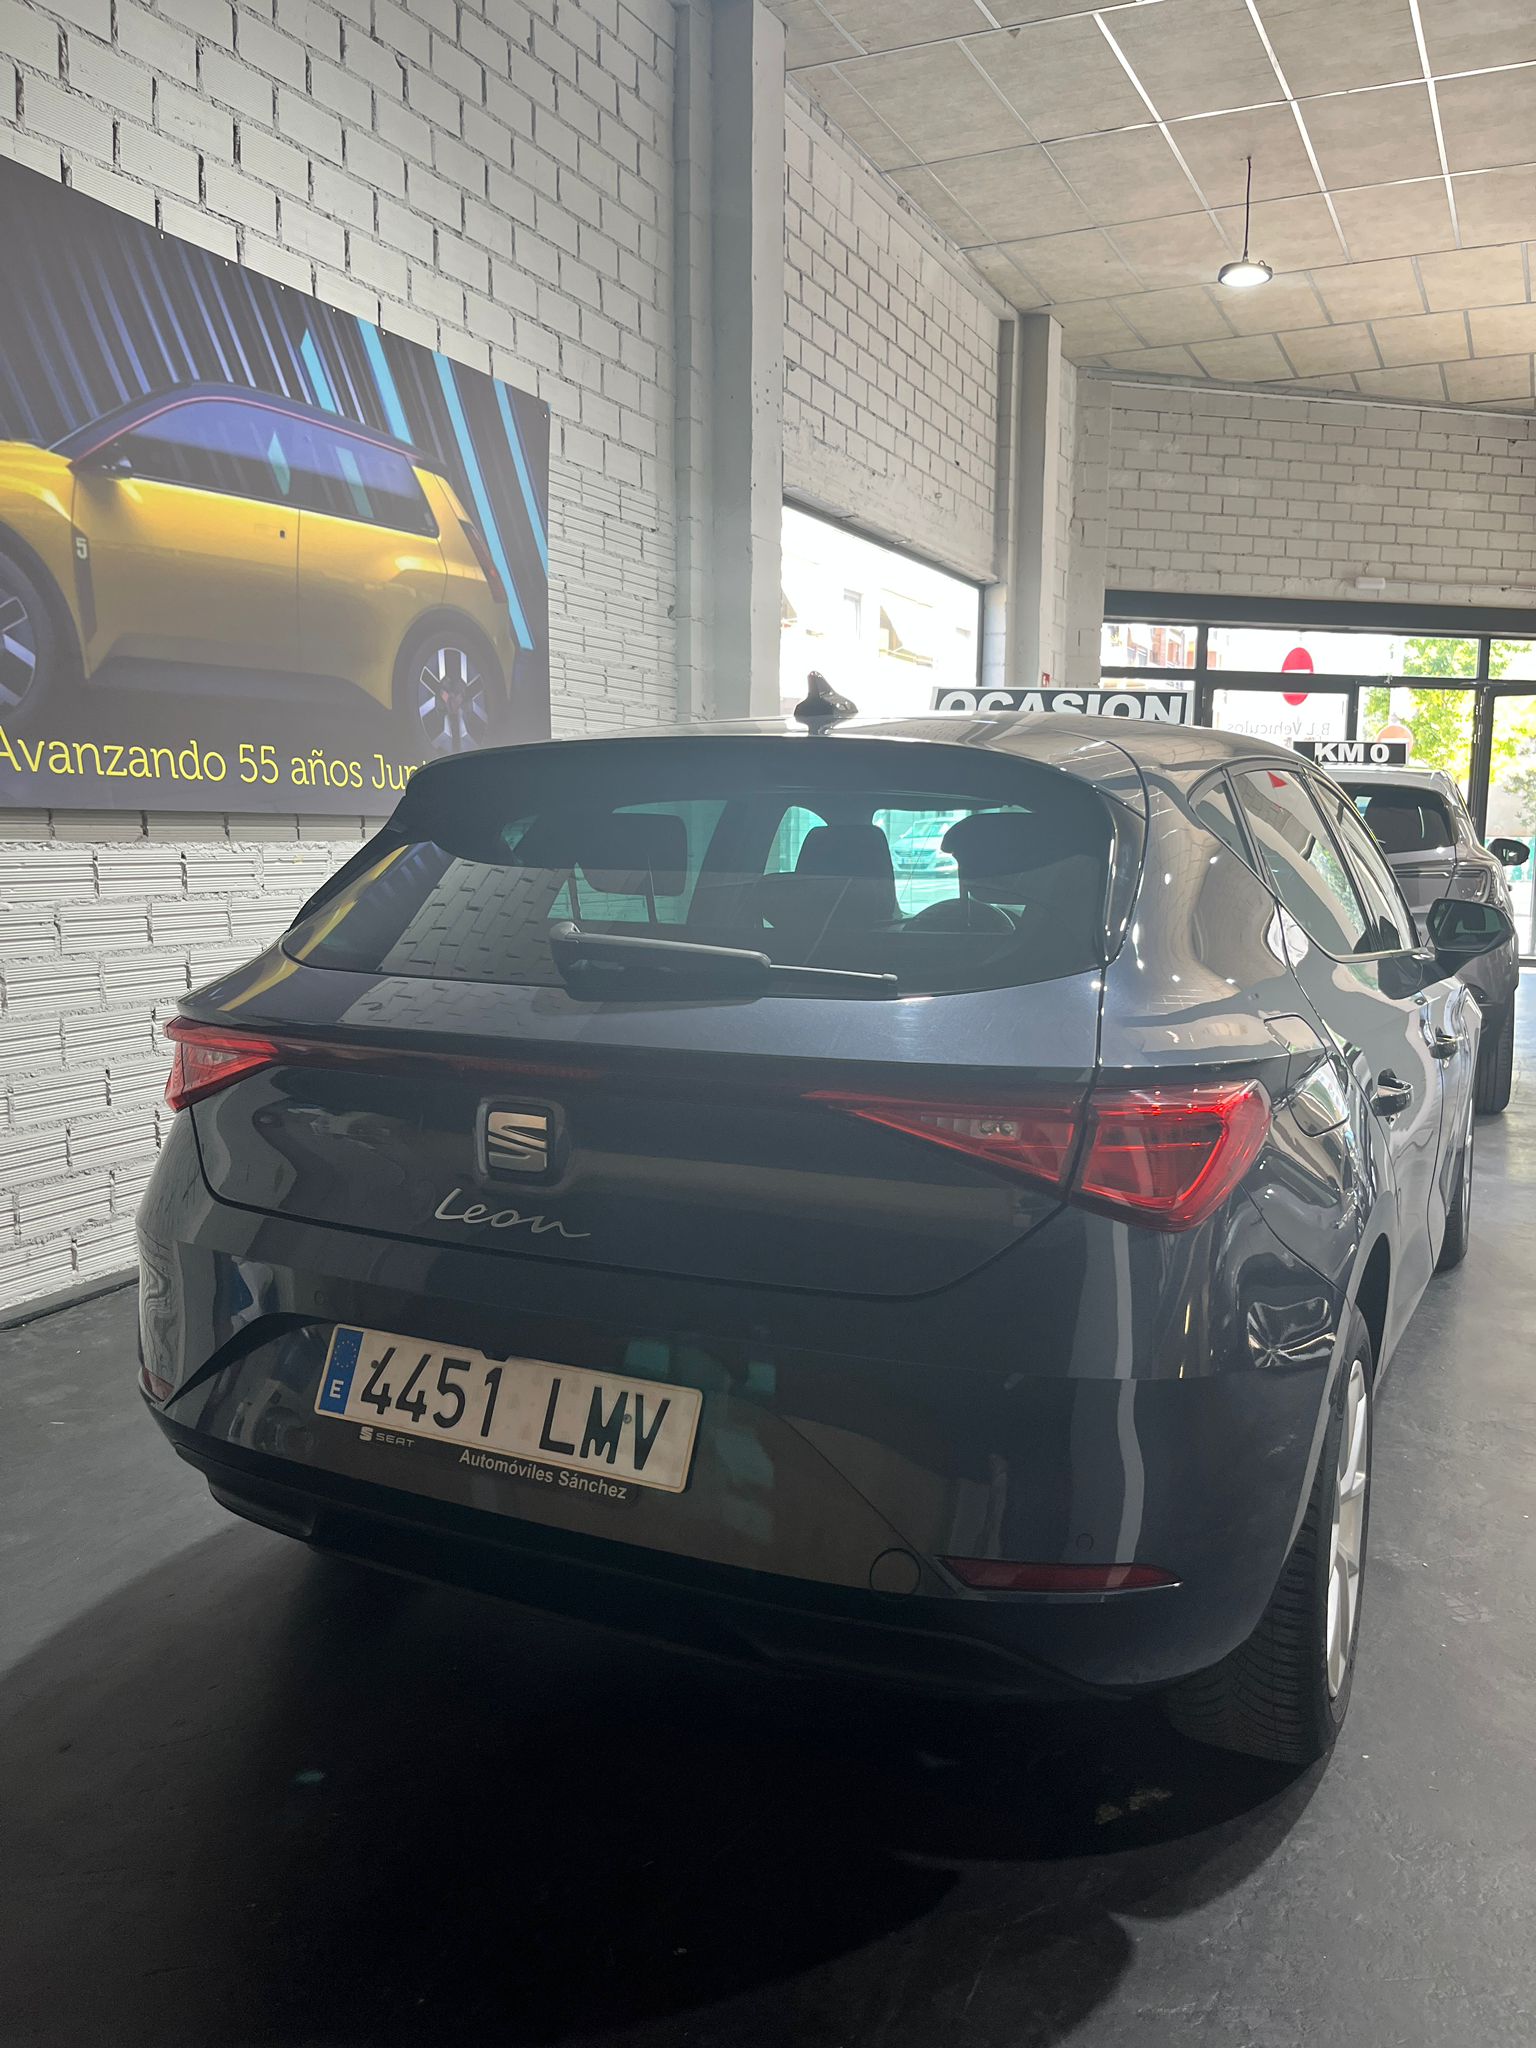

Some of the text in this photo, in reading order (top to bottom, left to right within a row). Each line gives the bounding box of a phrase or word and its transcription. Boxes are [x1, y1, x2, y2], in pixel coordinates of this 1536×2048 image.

[76, 537, 88, 559] 5
[938, 691, 1183, 724] OCASION
[0, 725, 426, 791] Avanzando 55 años Ju
[1314, 743, 1365, 763] KM
[434, 1187, 592, 1238] Leon
[329, 1379, 344, 1399] E
[360, 1346, 671, 1470] 4451 LMV
[375, 1432, 415, 1448] SEAT
[458, 1448, 628, 1500] Automóviles Sánchez
